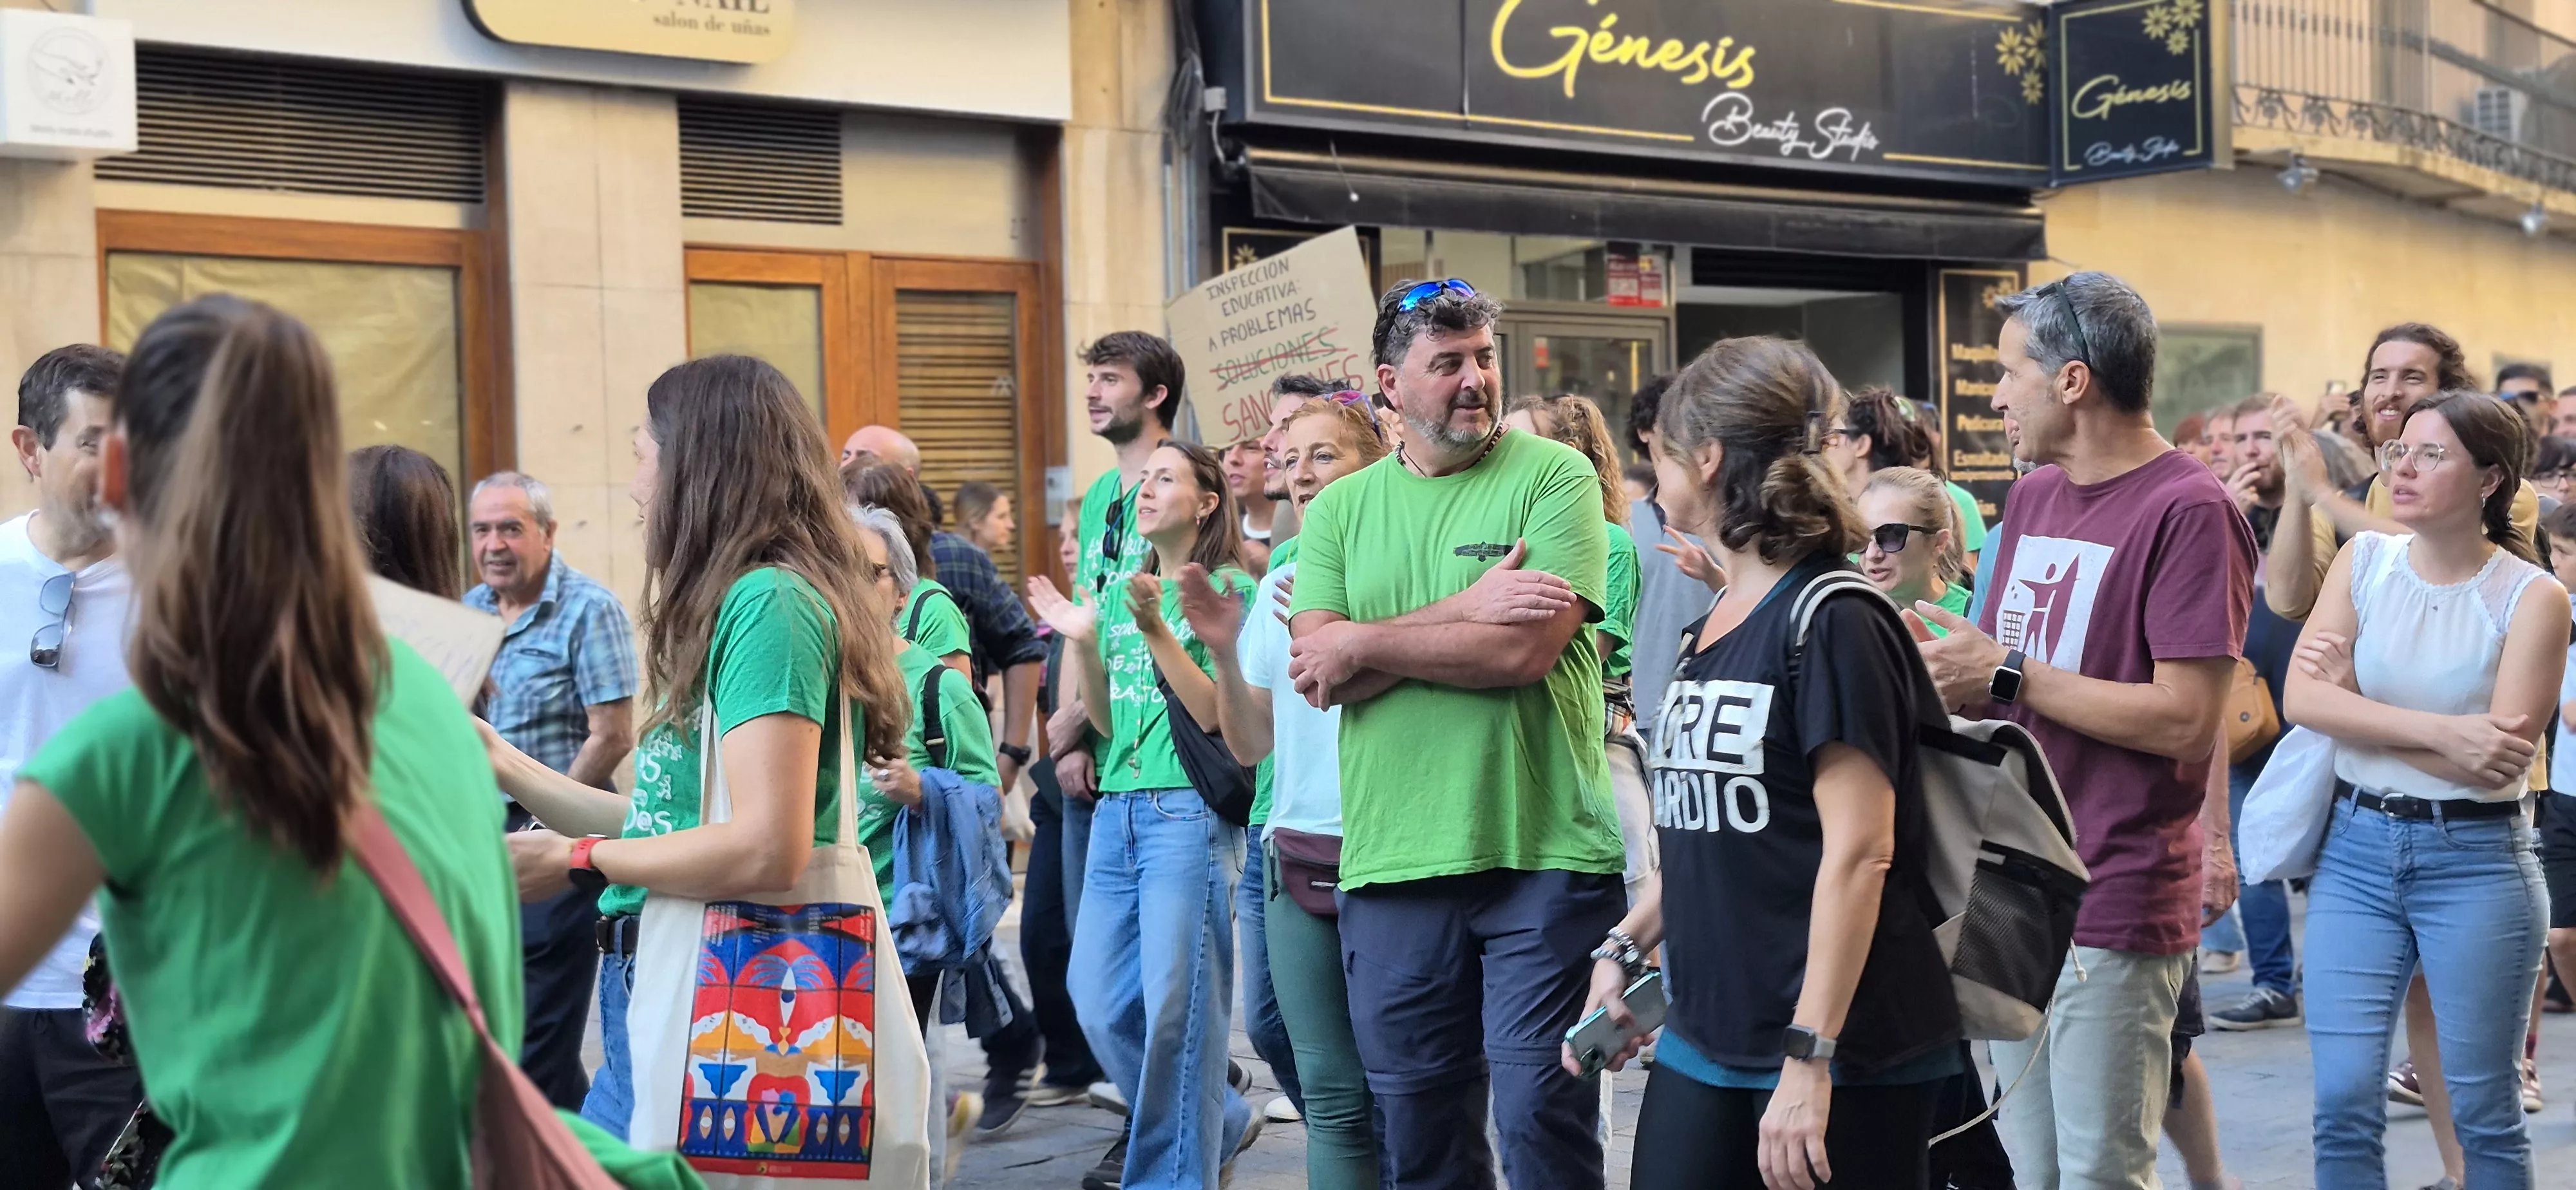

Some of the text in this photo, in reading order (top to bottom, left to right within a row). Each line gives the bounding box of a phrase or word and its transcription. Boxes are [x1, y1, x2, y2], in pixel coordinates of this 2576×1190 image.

[653, 11, 771, 35] salon de uñas
[1491, 0, 1756, 99] Génesis
[1701, 91, 1879, 162] Beauty Studio
[1209, 298, 1317, 353] A PROBLEMAS
[1216, 326, 1336, 385] SOLUCIONES
